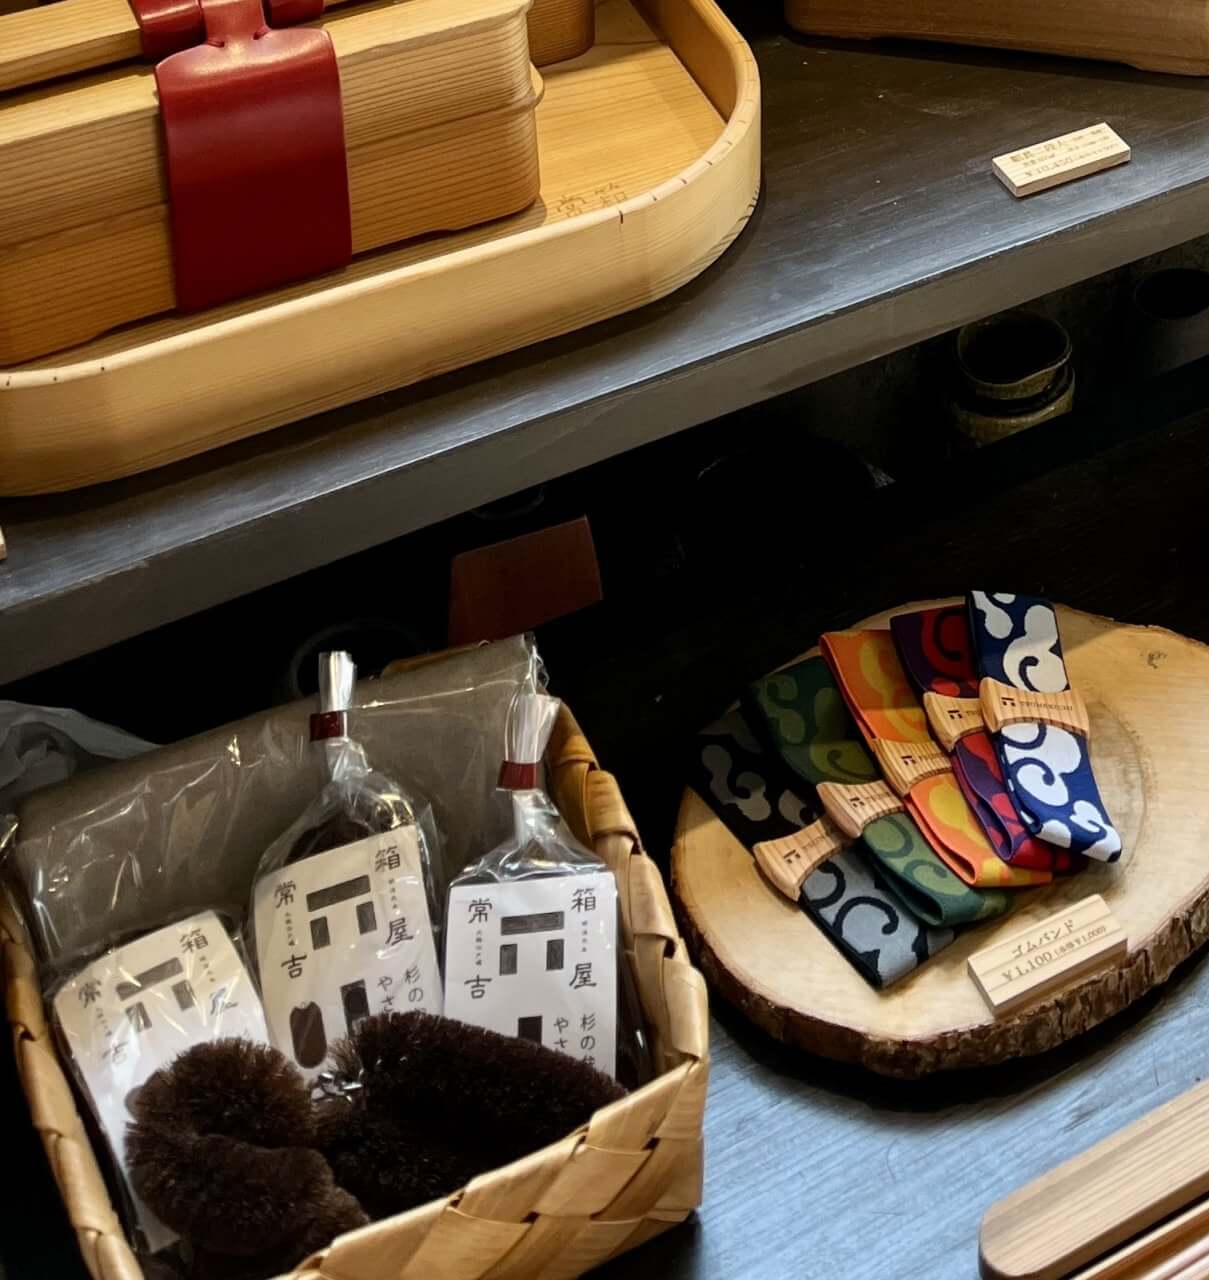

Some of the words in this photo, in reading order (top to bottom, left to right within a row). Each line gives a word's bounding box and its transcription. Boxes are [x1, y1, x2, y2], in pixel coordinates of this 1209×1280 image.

[1012, 919, 1076, 960] ゴムバンド
